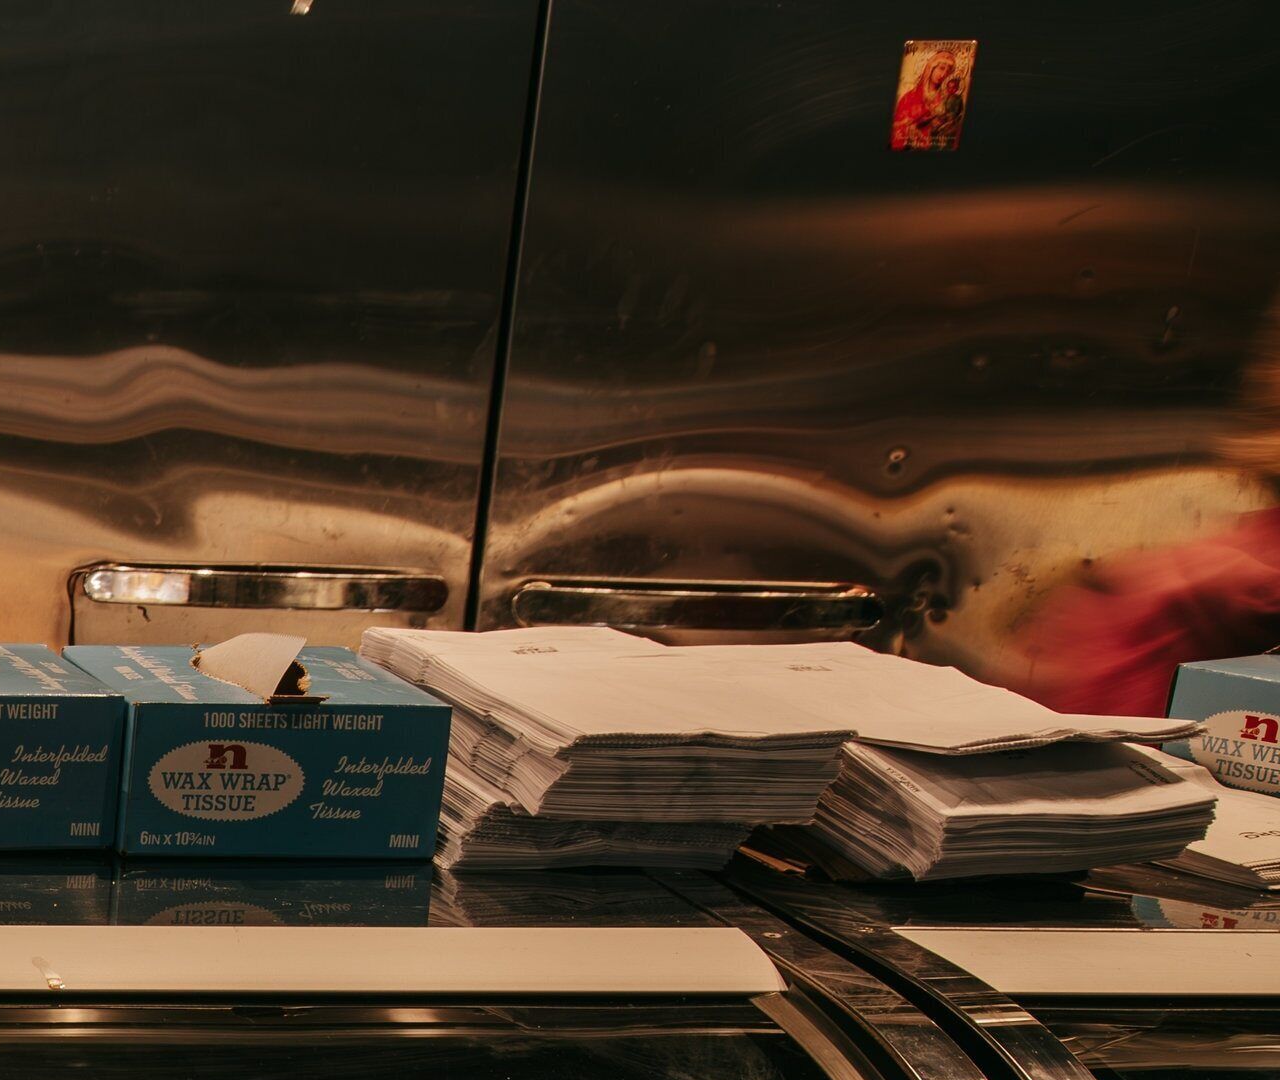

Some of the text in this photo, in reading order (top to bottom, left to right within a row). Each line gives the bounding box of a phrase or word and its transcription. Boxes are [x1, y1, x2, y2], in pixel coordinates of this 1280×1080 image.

[7, 704, 59, 720] WEIGHT
[203, 712, 384, 731] 1000 SHEETS LIGHT WEIGHT
[1201, 734, 1248, 758] WAX
[10, 744, 109, 768] Interfolded
[334, 755, 433, 780] Interfolded
[1215, 758, 1280, 785] TISSUE
[0, 768, 62, 786] Waxed
[161, 771, 213, 791] WAX
[322, 779, 384, 798] Waxed
[181, 794, 256, 812] TISSUE
[309, 802, 362, 820] Tissue
[69, 822, 101, 837] MINI
[140, 831, 161, 846] 6IN
[163, 833, 172, 846] X
[389, 834, 420, 849] MINI
